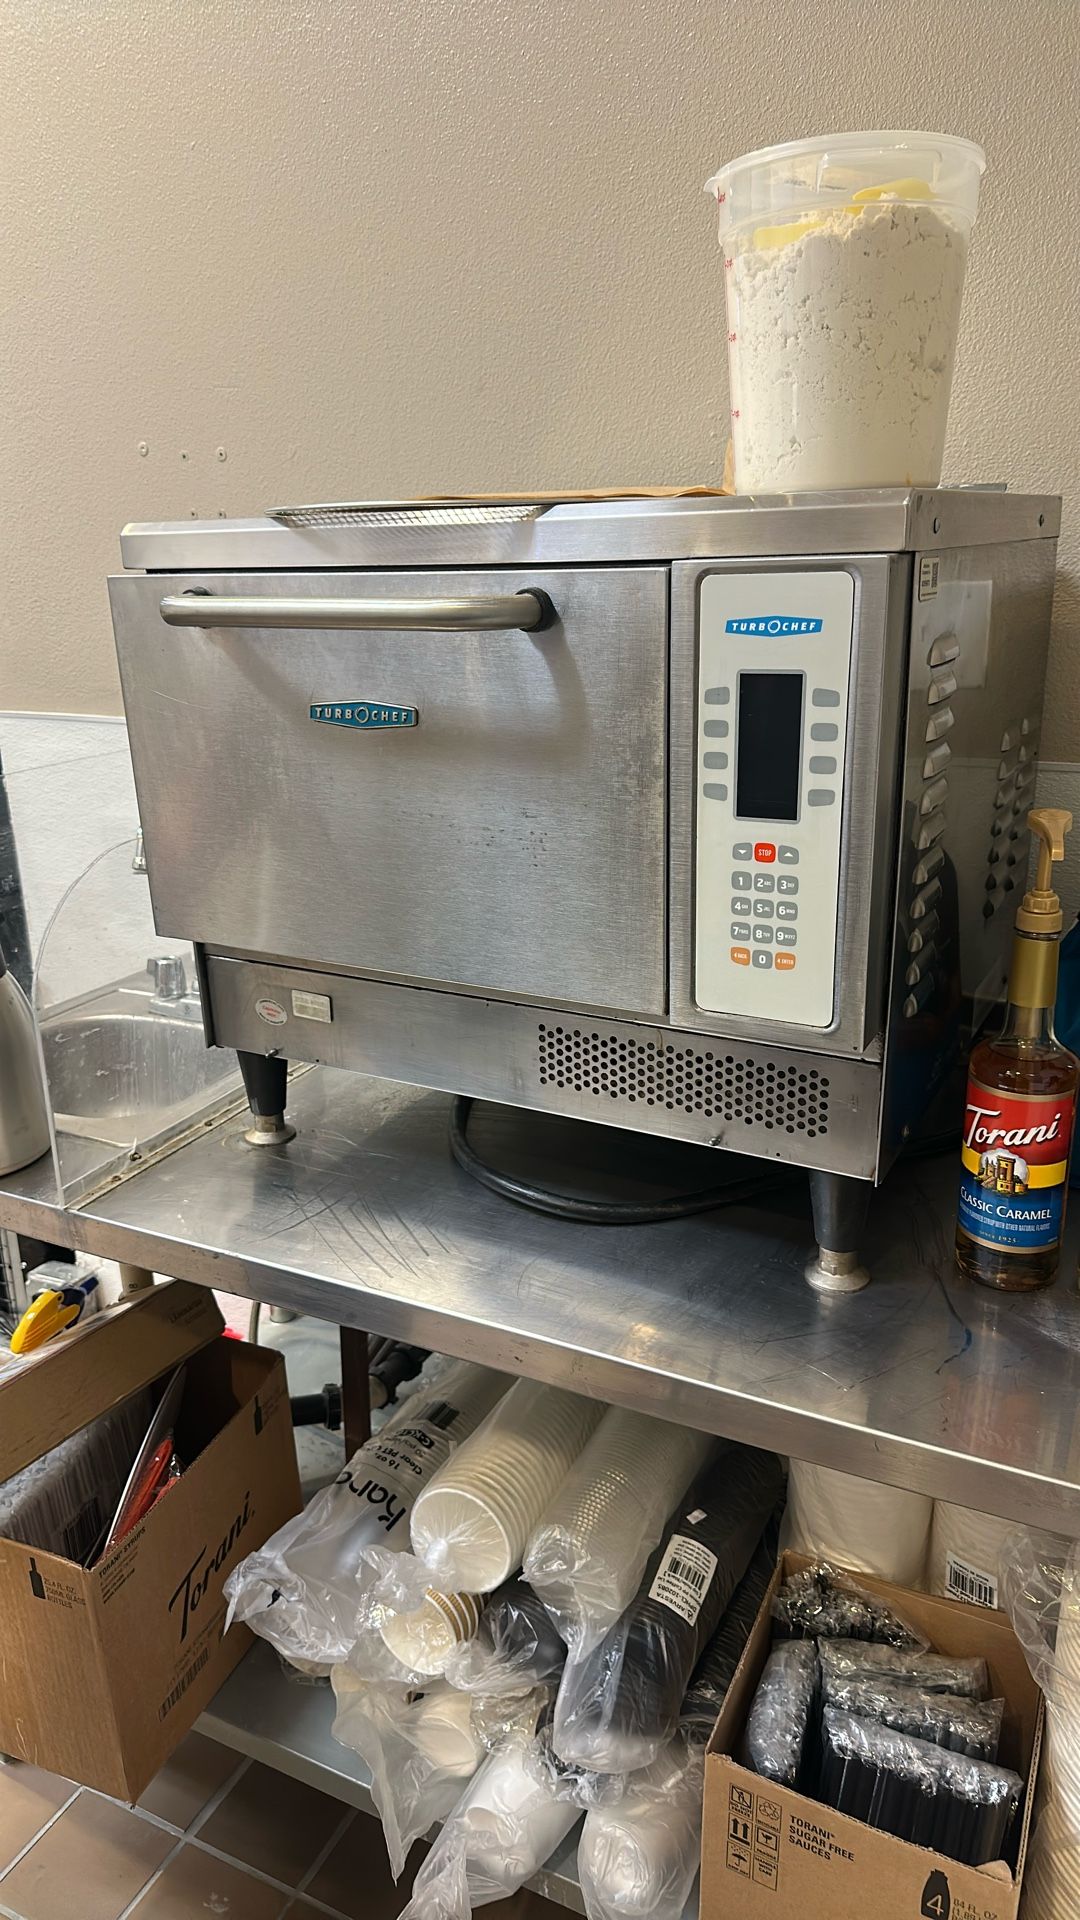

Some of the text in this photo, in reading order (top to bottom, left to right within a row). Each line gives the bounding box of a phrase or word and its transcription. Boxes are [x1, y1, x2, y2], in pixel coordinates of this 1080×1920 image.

[731, 619, 816, 634] TURBOCHEF
[315, 706, 408, 724] TURBOCHEF
[758, 848, 772, 857] STOP
[738, 876, 744, 886] 1
[756, 878, 764, 888] 2
[780, 880, 787, 890] 3
[734, 902, 741, 911] 4
[756, 904, 763, 913] 5
[778, 906, 786, 916] 6
[732, 926, 739, 936] 7
[756, 930, 763, 939] 8
[777, 932, 784, 940] 9
[758, 954, 766, 964] 0
[966, 1103, 1061, 1148] Torani
[960, 1186, 994, 1214] CLASSIC
[996, 1206, 1052, 1220] CARAMEL
[382, 1446, 400, 1457] PET
[388, 1460, 400, 1470] 16
[400, 1454, 422, 1475] Clear
[168, 1490, 250, 1644] Torani
[656, 1592, 686, 1612] ARVESTA
[788, 1834, 832, 1860] SAUCES
[789, 1824, 855, 1862] SUGAR FREE
[926, 1894, 944, 1916] 4
